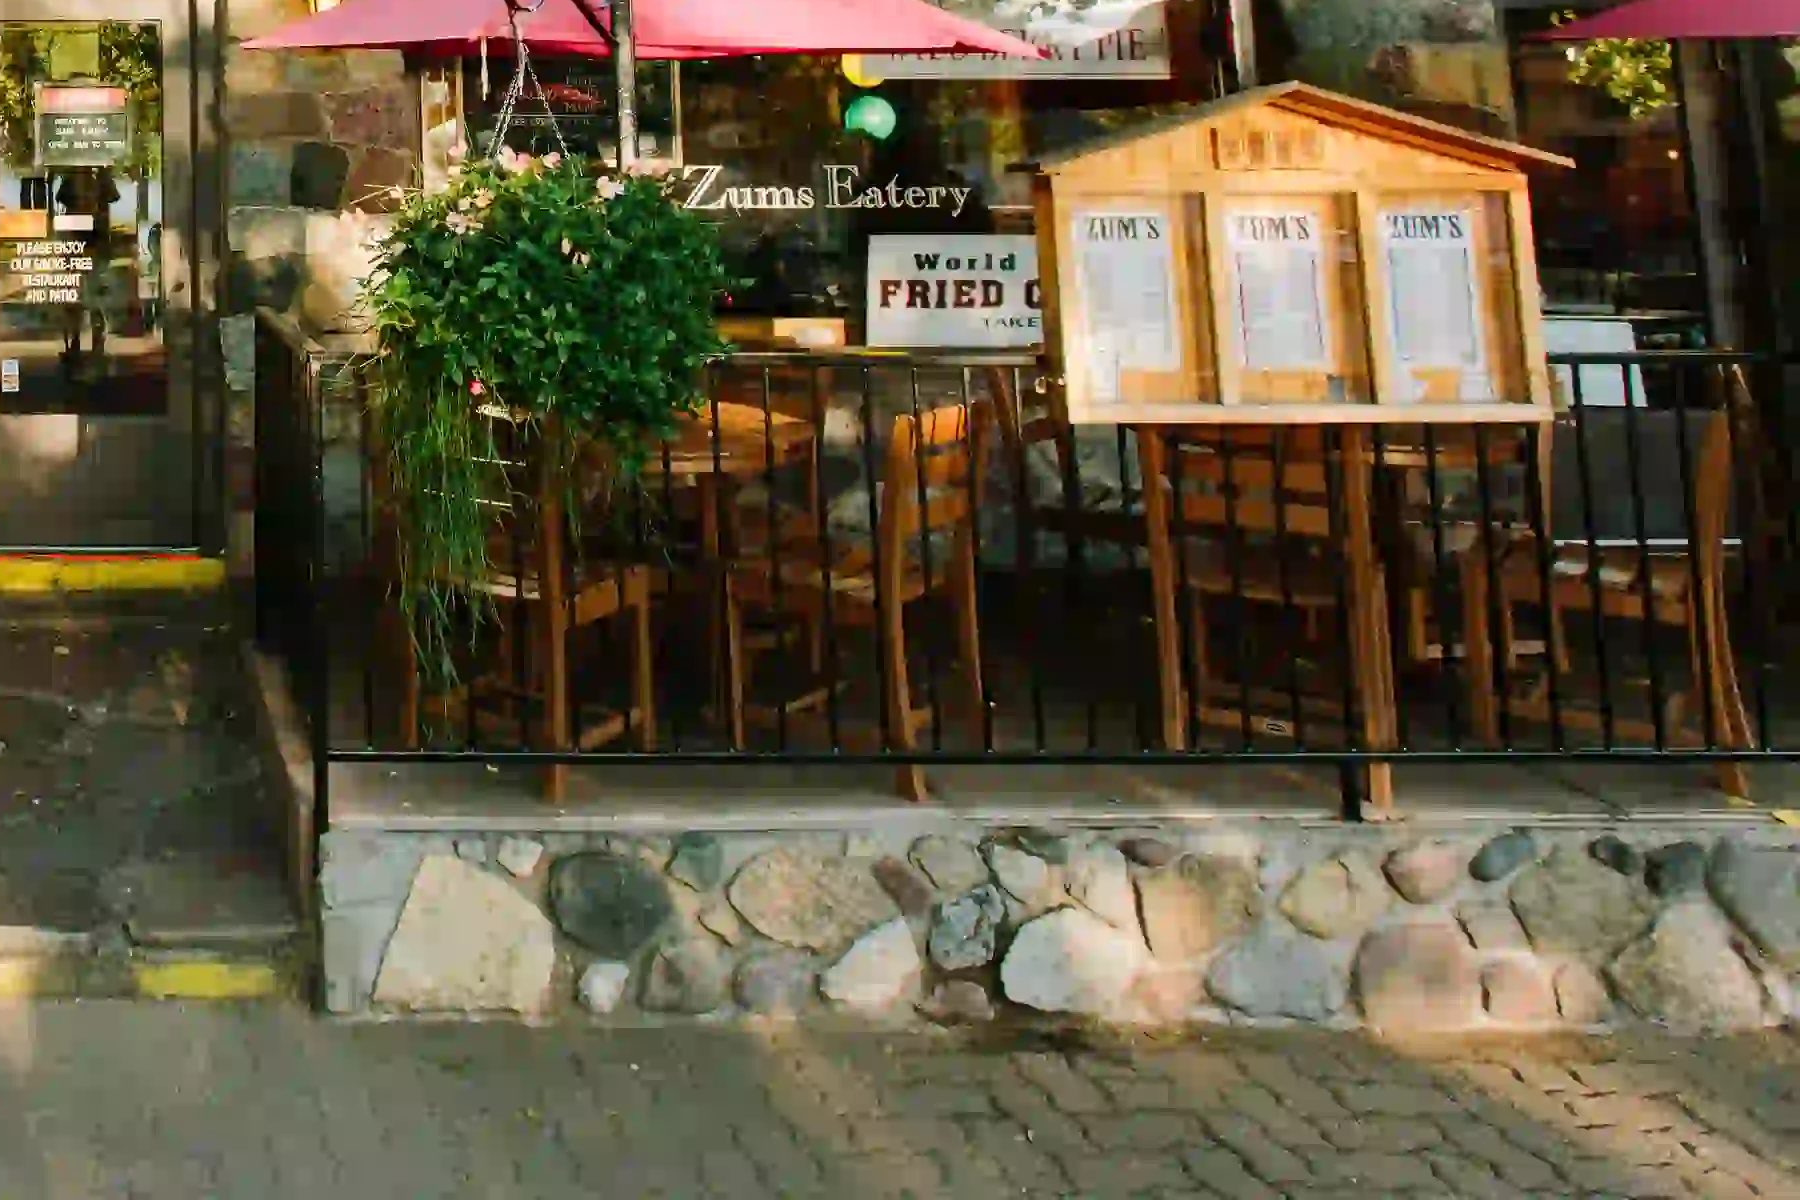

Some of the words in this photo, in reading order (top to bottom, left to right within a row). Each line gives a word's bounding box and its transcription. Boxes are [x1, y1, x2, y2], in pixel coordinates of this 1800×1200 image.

[681, 164, 816, 210] Zums
[822, 164, 972, 218] Eatery
[15, 240, 52, 255] PLEASE
[53, 240, 87, 255] ENJOY
[913, 252, 1017, 272] World
[25, 288, 46, 304] AND
[48, 288, 79, 303] PATIO
[879, 279, 1004, 309] FRIED
[982, 316, 1042, 331] TAKE
